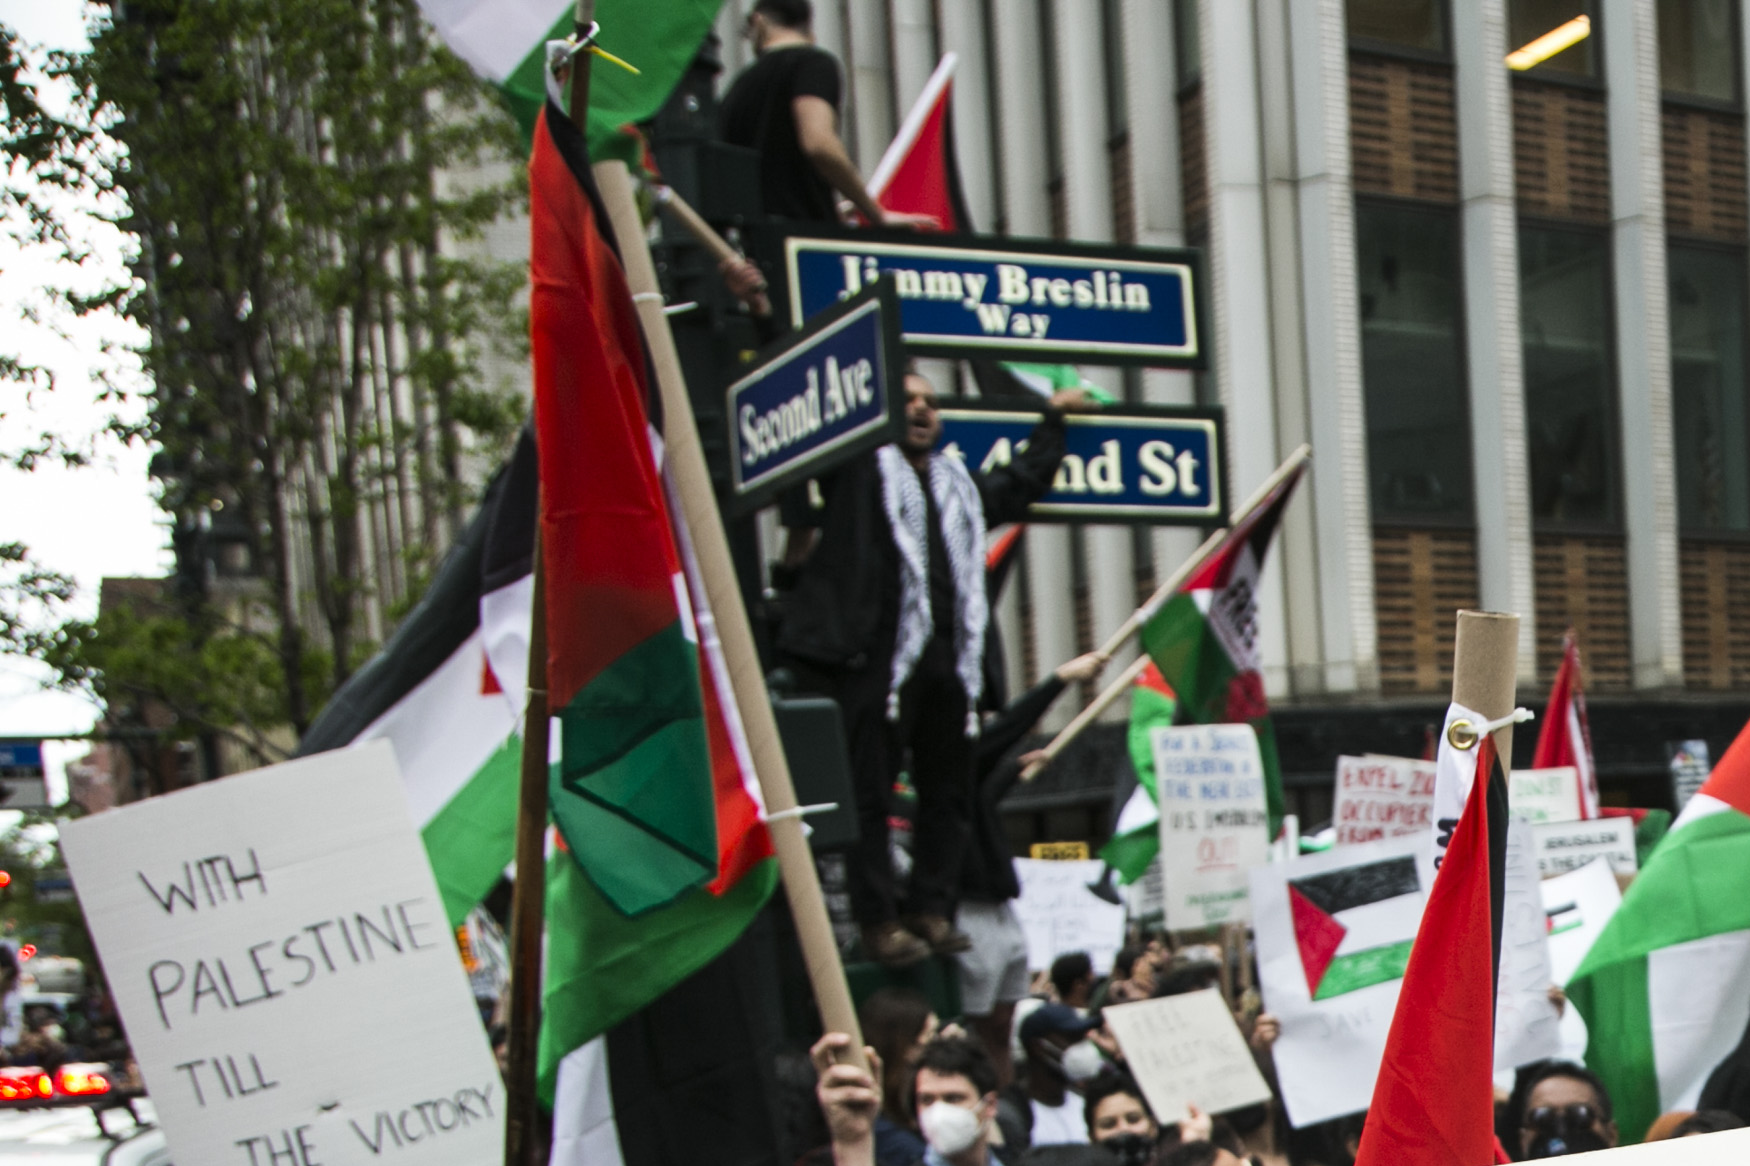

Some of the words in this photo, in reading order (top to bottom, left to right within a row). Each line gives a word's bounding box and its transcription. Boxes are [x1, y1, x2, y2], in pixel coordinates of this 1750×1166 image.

[996, 264, 1151, 311] Breslin
[975, 303, 1051, 340] Way
[738, 365, 822, 467] Second
[823, 355, 875, 426] Ave
[1139, 440, 1202, 497] St
[137, 848, 267, 915] WITH
[147, 897, 440, 1030] PALESTINE
[175, 1053, 279, 1107] TILL
[349, 1083, 497, 1155] VICTORY
